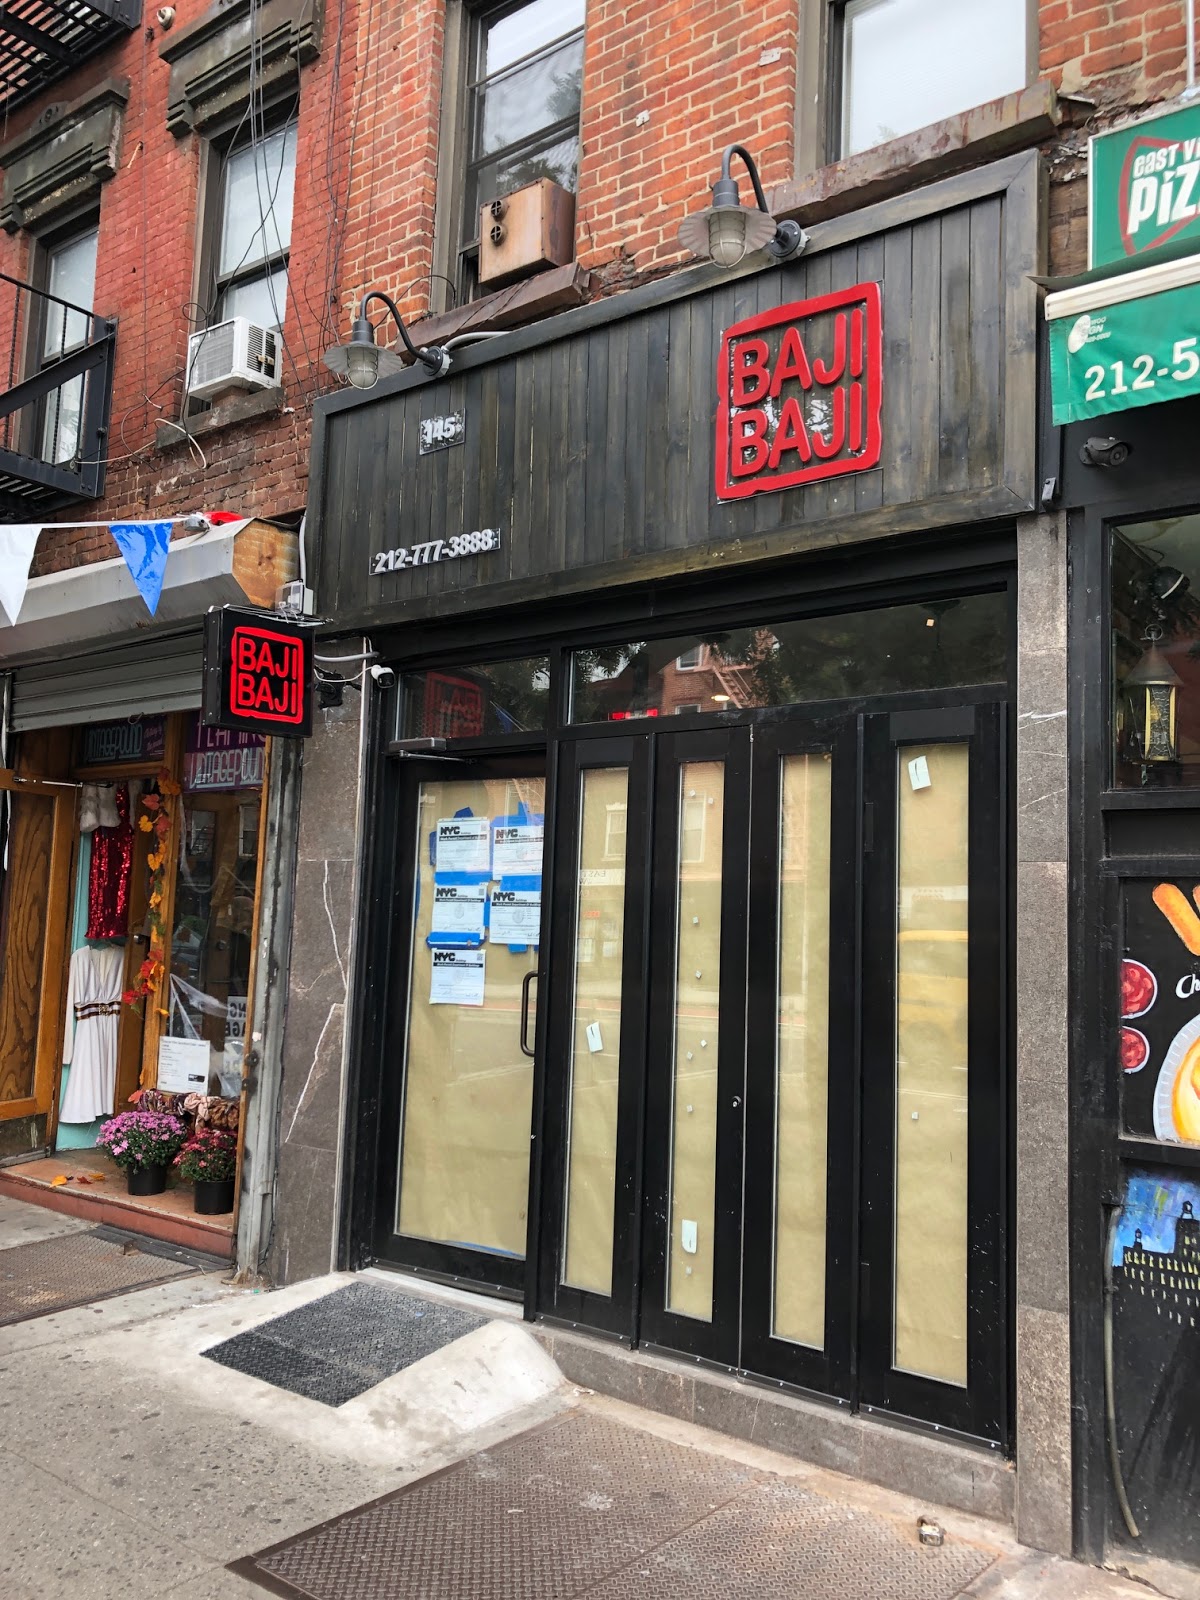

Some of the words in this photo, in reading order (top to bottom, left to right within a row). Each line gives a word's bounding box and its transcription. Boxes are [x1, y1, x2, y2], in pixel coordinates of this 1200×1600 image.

[732, 308, 863, 407] BAJI
[423, 416, 456, 444] 145
[731, 382, 862, 478] BAJI
[375, 529, 492, 573] 212-777-3888
[239, 637, 297, 680] BAJI
[238, 672, 297, 714] BAJI
[440, 826, 460, 836] NYC
[496, 828, 518, 839] NYC
[436, 887, 457, 898] NYC
[493, 892, 515, 902] NYC
[434, 952, 456, 962] NYC
